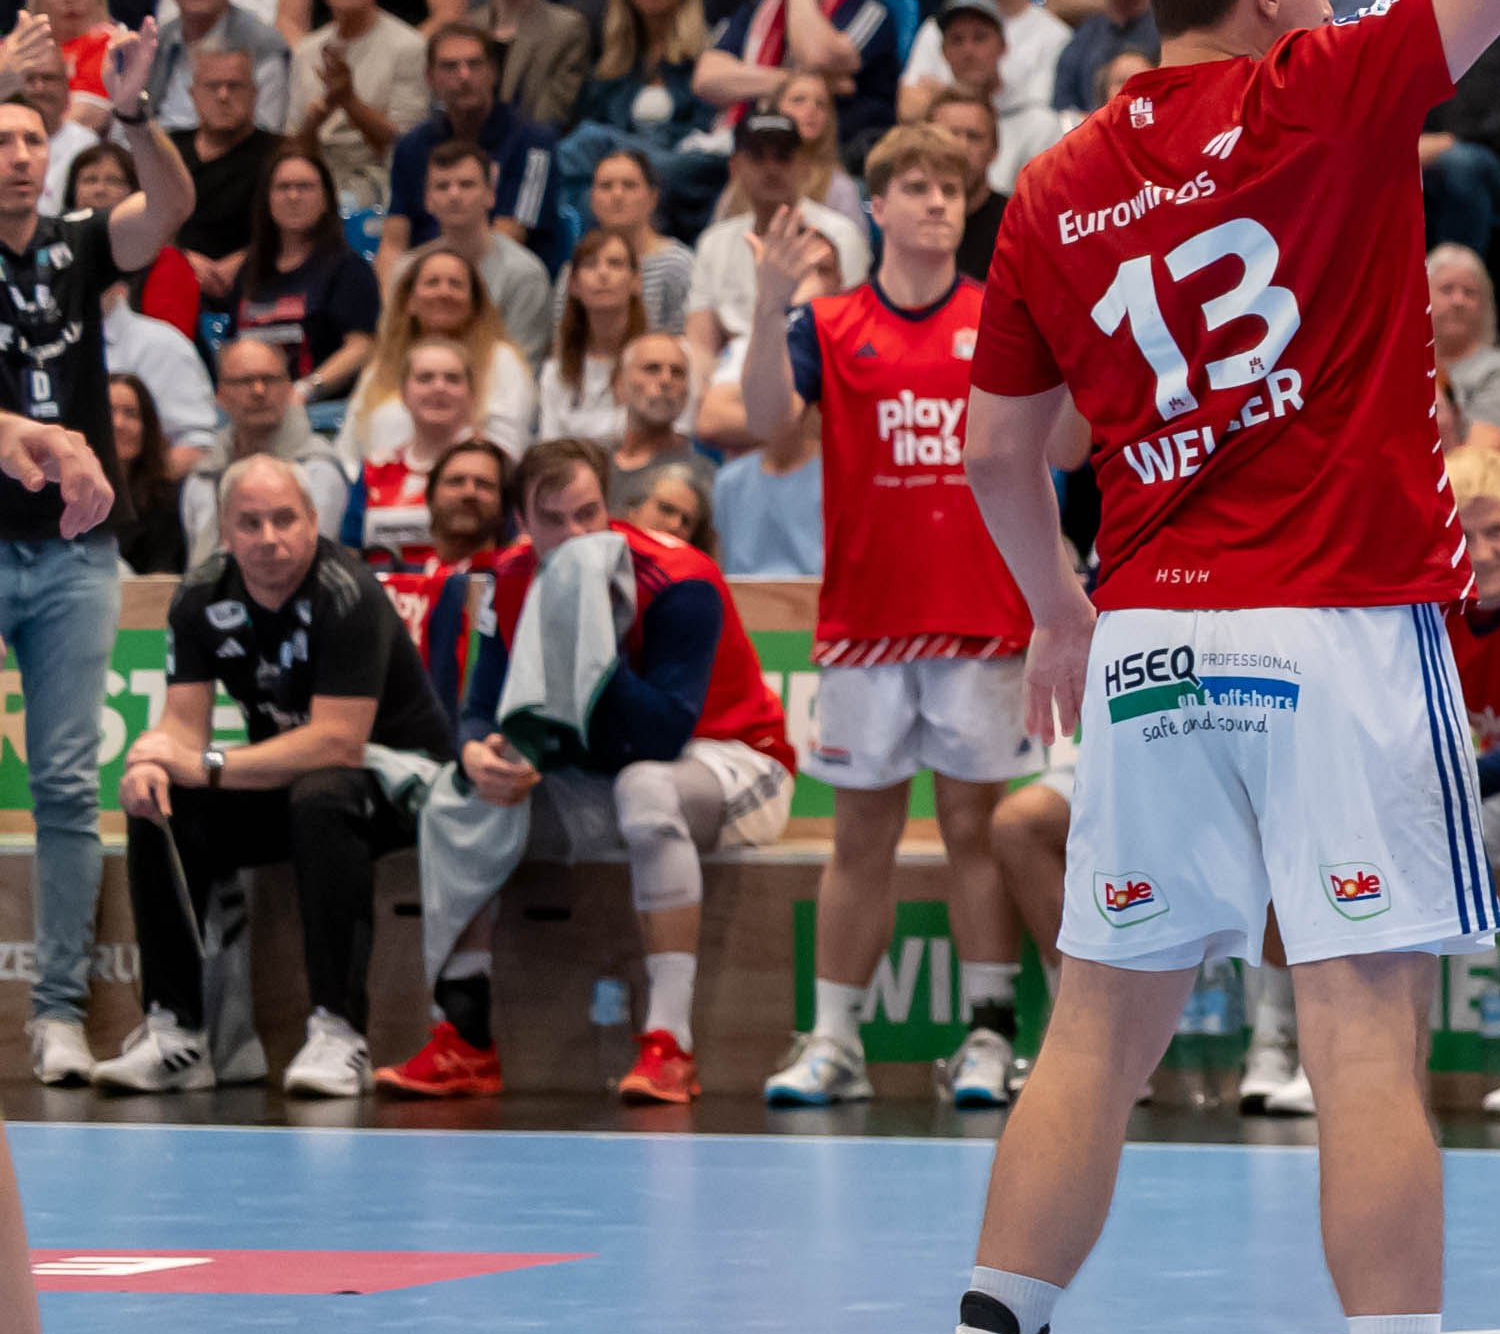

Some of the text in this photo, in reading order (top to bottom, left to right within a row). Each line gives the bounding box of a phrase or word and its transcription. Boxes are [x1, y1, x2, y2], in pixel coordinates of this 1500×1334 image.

[1058, 169, 1217, 245] Eurowings
[1091, 217, 1302, 422] 13
[877, 388, 965, 442] play
[1155, 568, 1211, 584] HSVH
[1105, 645, 1302, 697] HSEQ PROFESSIONAL
[1219, 689, 1294, 709] offshore
[1143, 711, 1269, 742] safe and sound
[1105, 879, 1154, 905] Dole
[1330, 871, 1382, 900] Dole
